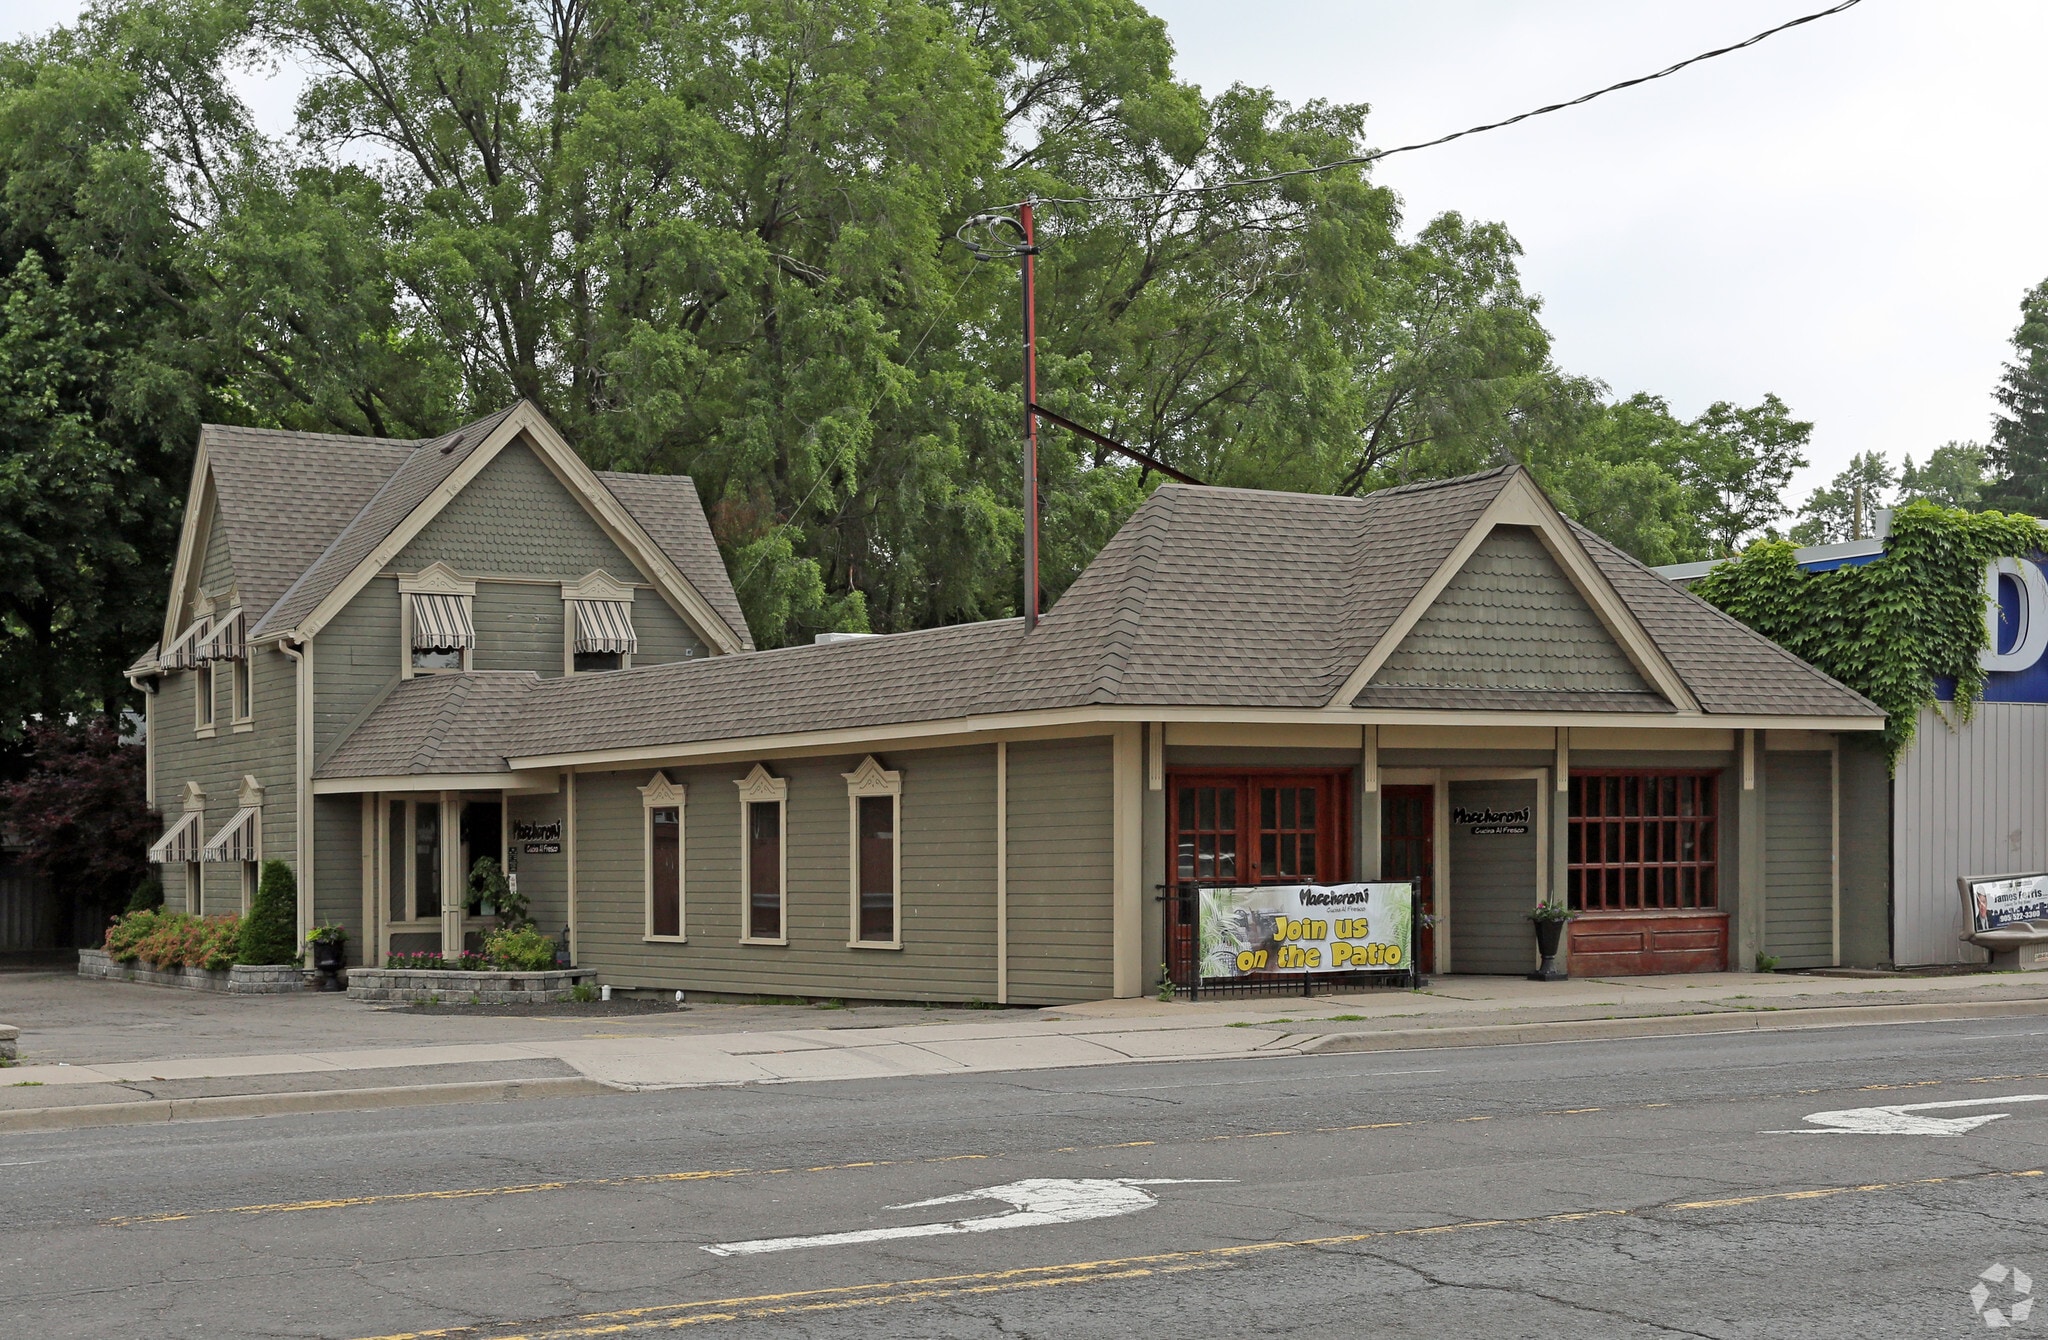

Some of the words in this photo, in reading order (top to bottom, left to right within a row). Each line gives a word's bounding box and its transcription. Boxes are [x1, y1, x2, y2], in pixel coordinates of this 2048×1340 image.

[1453, 806, 1531, 825] Maccheroni
[513, 818, 562, 841] Maccheroni
[544, 844, 558, 852] Fresco
[1299, 888, 1369, 907] Maccheroni
[1273, 916, 1327, 942] Join
[1334, 918, 1369, 940] us
[1236, 949, 1269, 972] on
[1277, 944, 1321, 969] the
[1330, 941, 1402, 967] Patio
